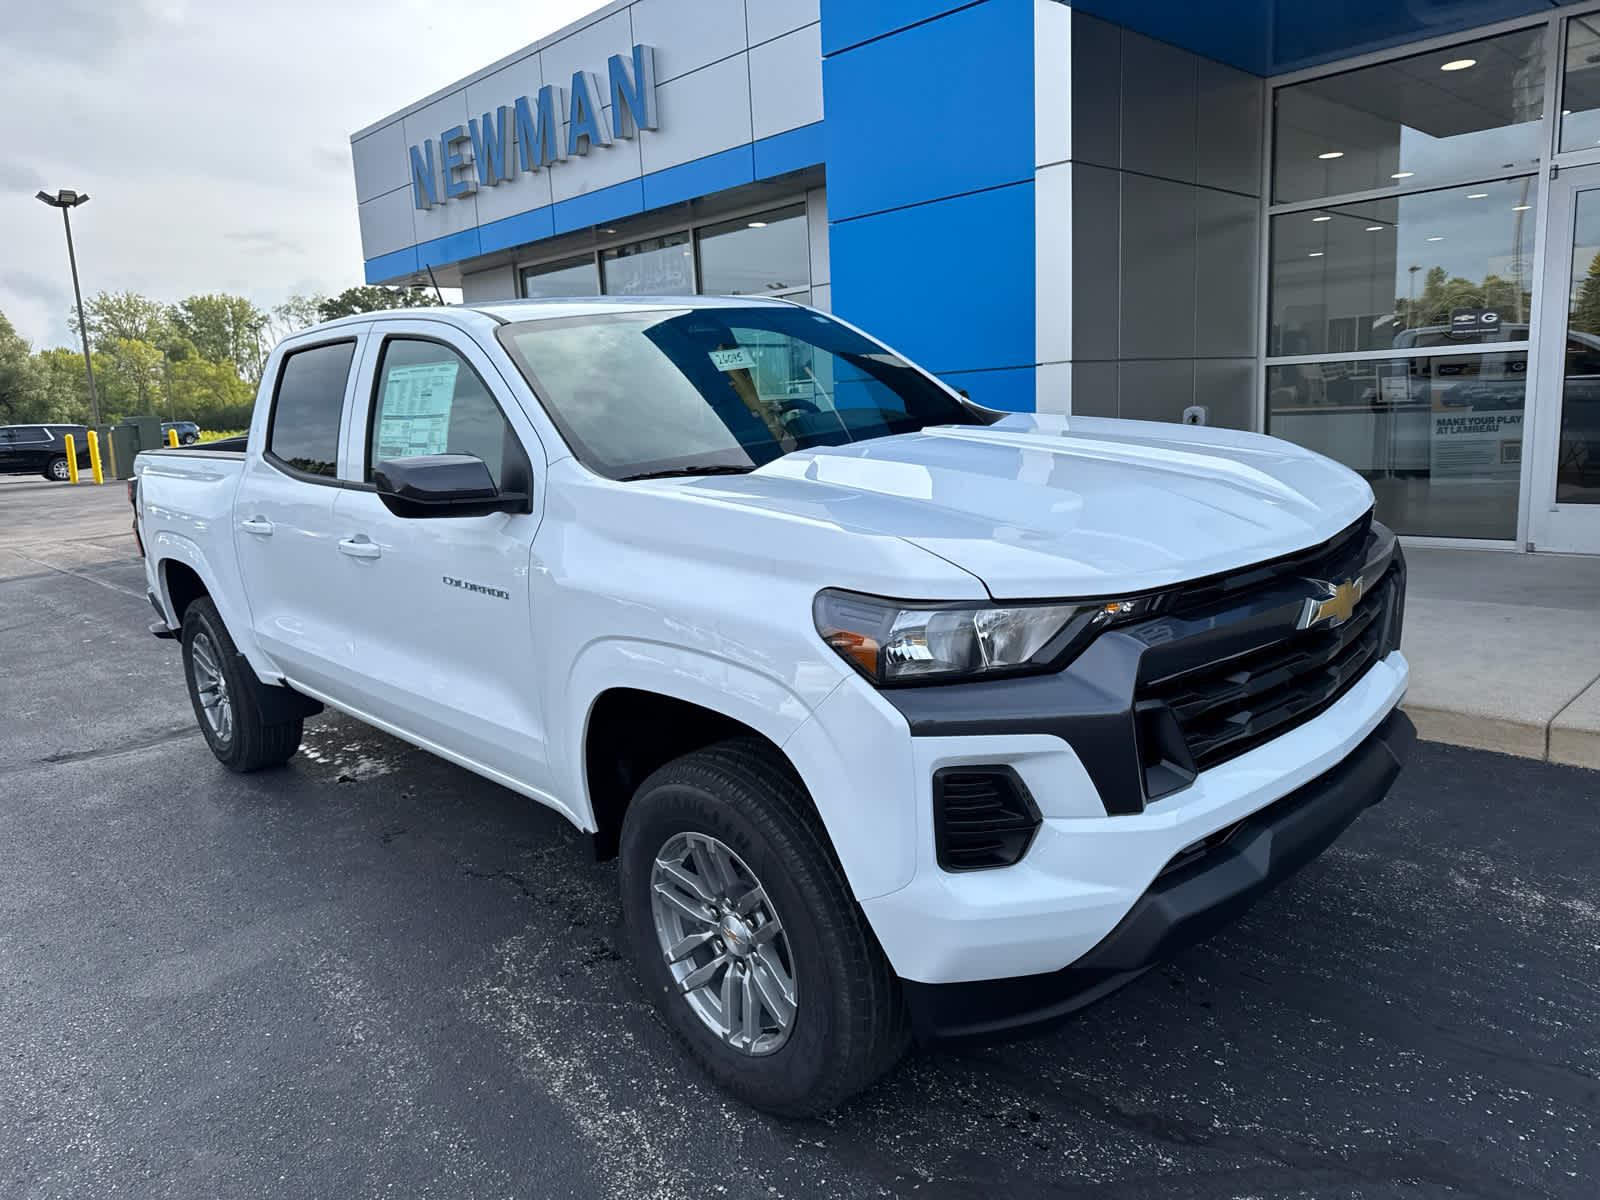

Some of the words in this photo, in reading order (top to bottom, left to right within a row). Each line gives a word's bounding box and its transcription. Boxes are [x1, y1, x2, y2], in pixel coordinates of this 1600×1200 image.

[409, 44, 659, 210] NEWMAN
[1481, 313, 1498, 323] G
[1435, 417, 1466, 426] MAKE
[1467, 416, 1497, 425] YOUR
[1497, 415, 1522, 424] PLAY
[1435, 426, 1449, 434] AT
[1450, 425, 1499, 434] LAMBEAU
[442, 576, 509, 600] COLORADO
